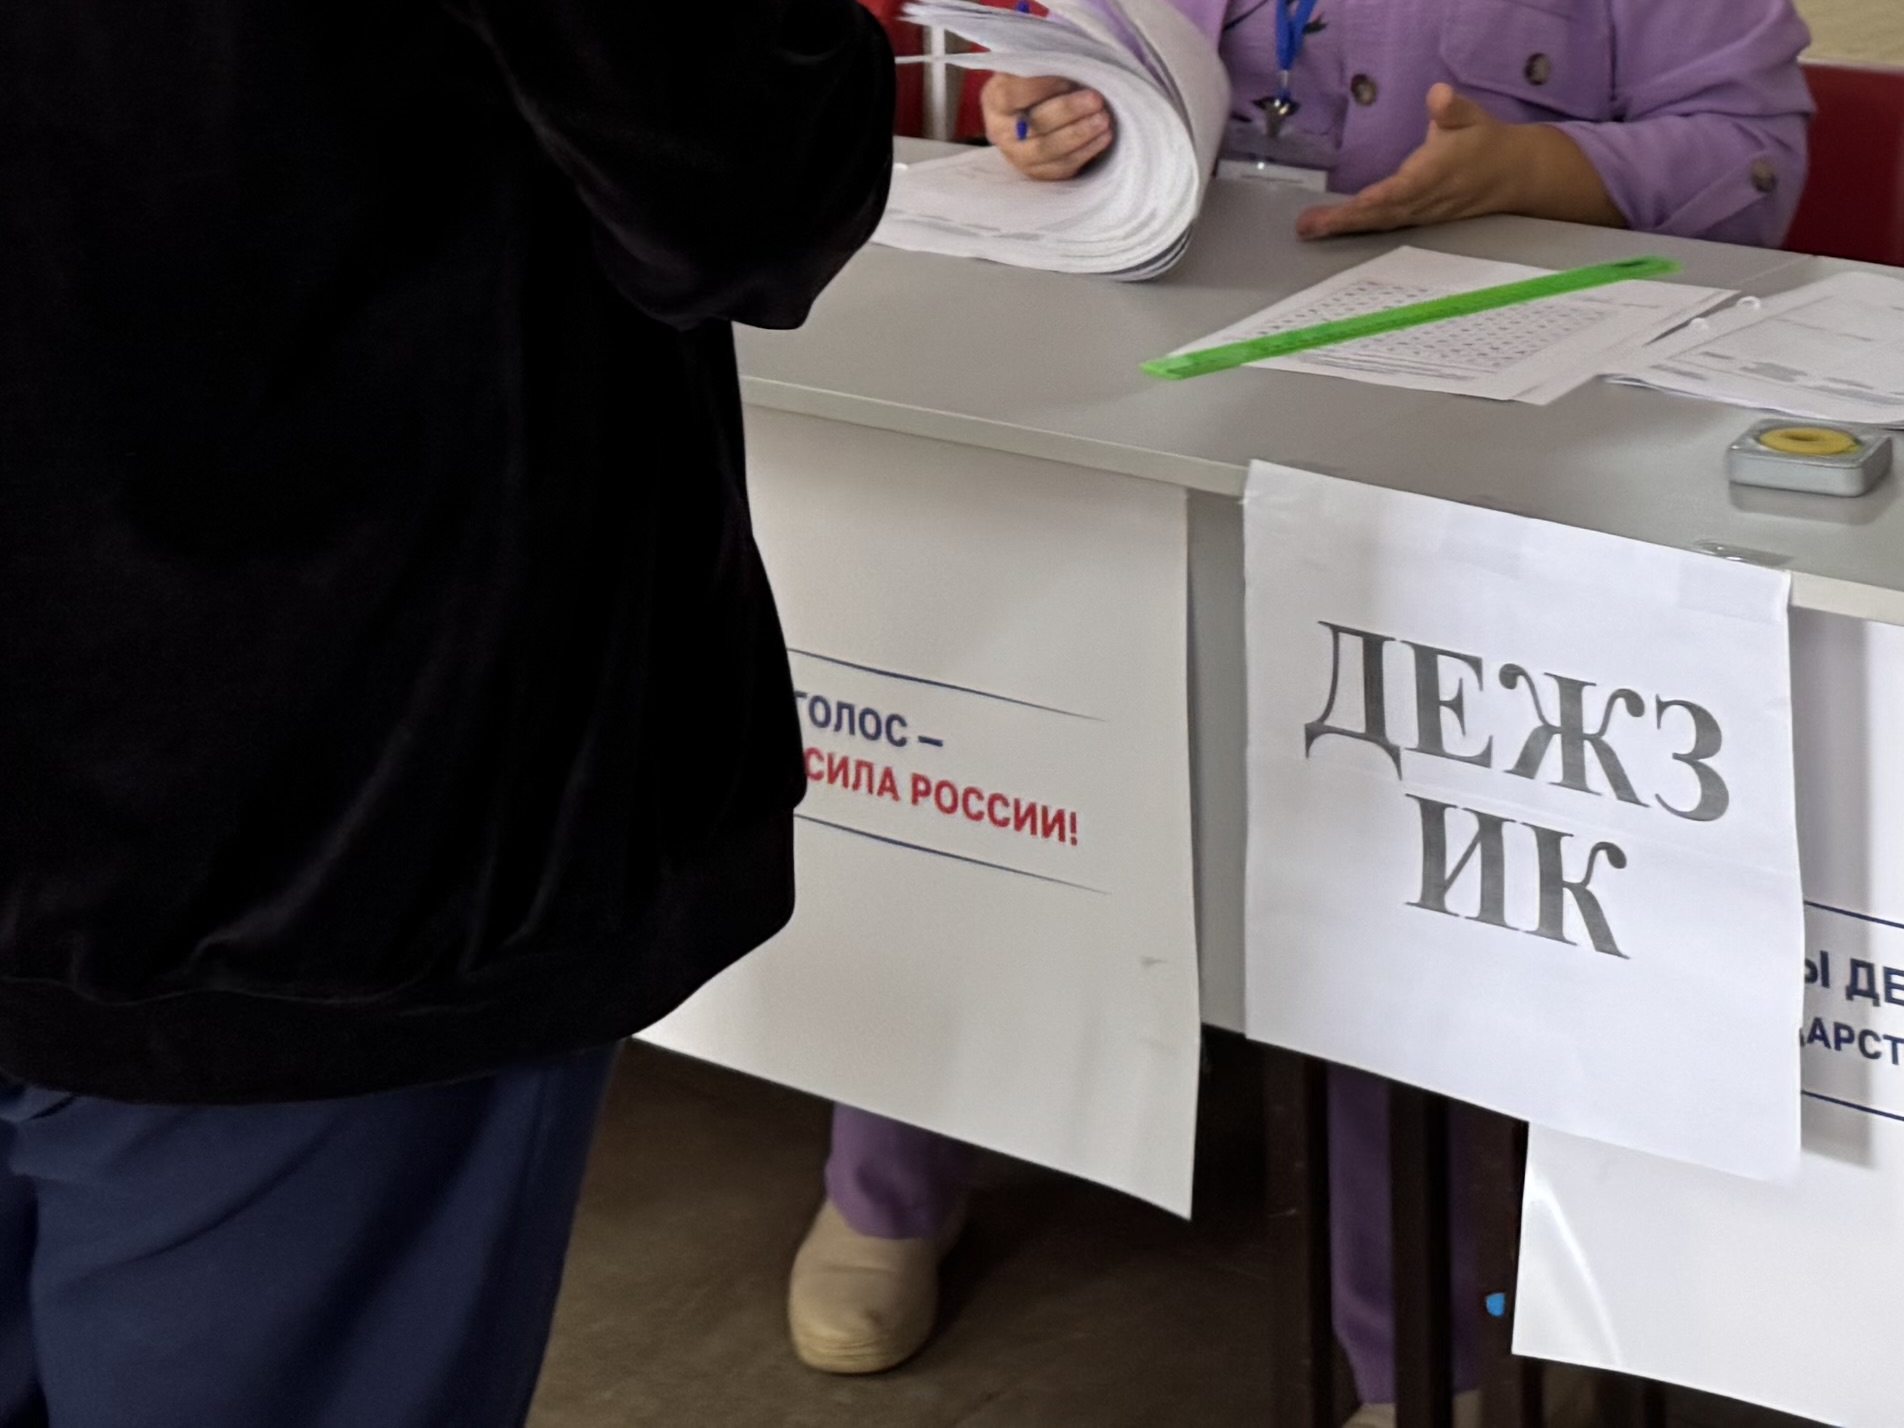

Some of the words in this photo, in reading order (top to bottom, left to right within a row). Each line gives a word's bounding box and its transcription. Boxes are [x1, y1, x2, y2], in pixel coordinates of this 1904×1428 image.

[805, 747, 901, 802] СИЛА
[911, 772, 1078, 847] РОССИИ!
[1305, 620, 1730, 823] ДЕЖЗ
[1404, 793, 1632, 961] ИК
